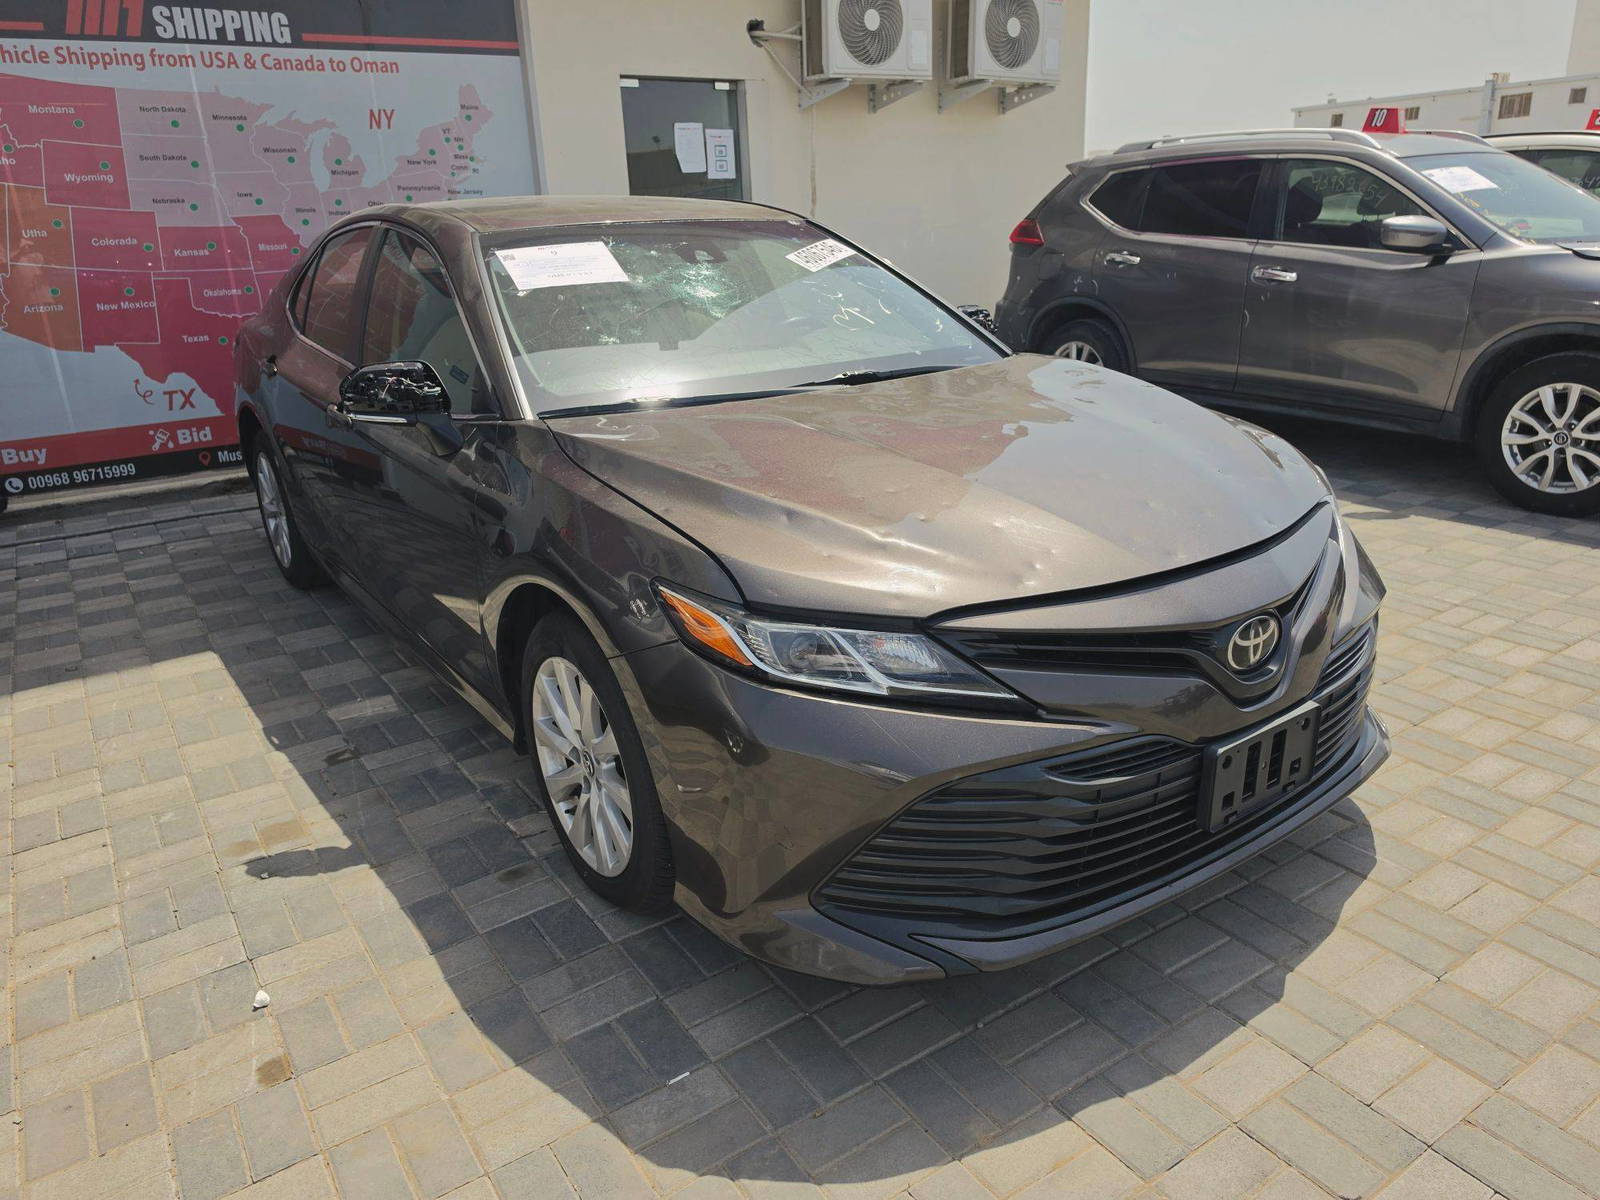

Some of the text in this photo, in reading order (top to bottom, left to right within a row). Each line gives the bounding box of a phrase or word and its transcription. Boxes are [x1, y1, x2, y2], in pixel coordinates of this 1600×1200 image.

[152, 5, 291, 44] SHIPPING
[54, 46, 145, 71] Shipping
[150, 48, 196, 68] from
[201, 52, 239, 70] USA
[244, 54, 256, 70] &
[261, 53, 325, 72] Canada
[329, 57, 346, 72] to
[351, 57, 399, 74] Oman
[28, 104, 75, 114] Montana
[368, 109, 395, 130] NY
[1371, 109, 1388, 127] 10
[64, 172, 114, 184] Wyoming
[174, 248, 209, 257] Kansas
[258, 243, 287, 251] Missouri
[24, 303, 63, 314] Arizona
[96, 300, 155, 311] New Mexico
[182, 334, 209, 343] Texas
[163, 388, 196, 411] TX
[177, 427, 212, 445] Bid
[2, 448, 47, 465] Buy
[28, 463, 136, 490] 00968 96715999
